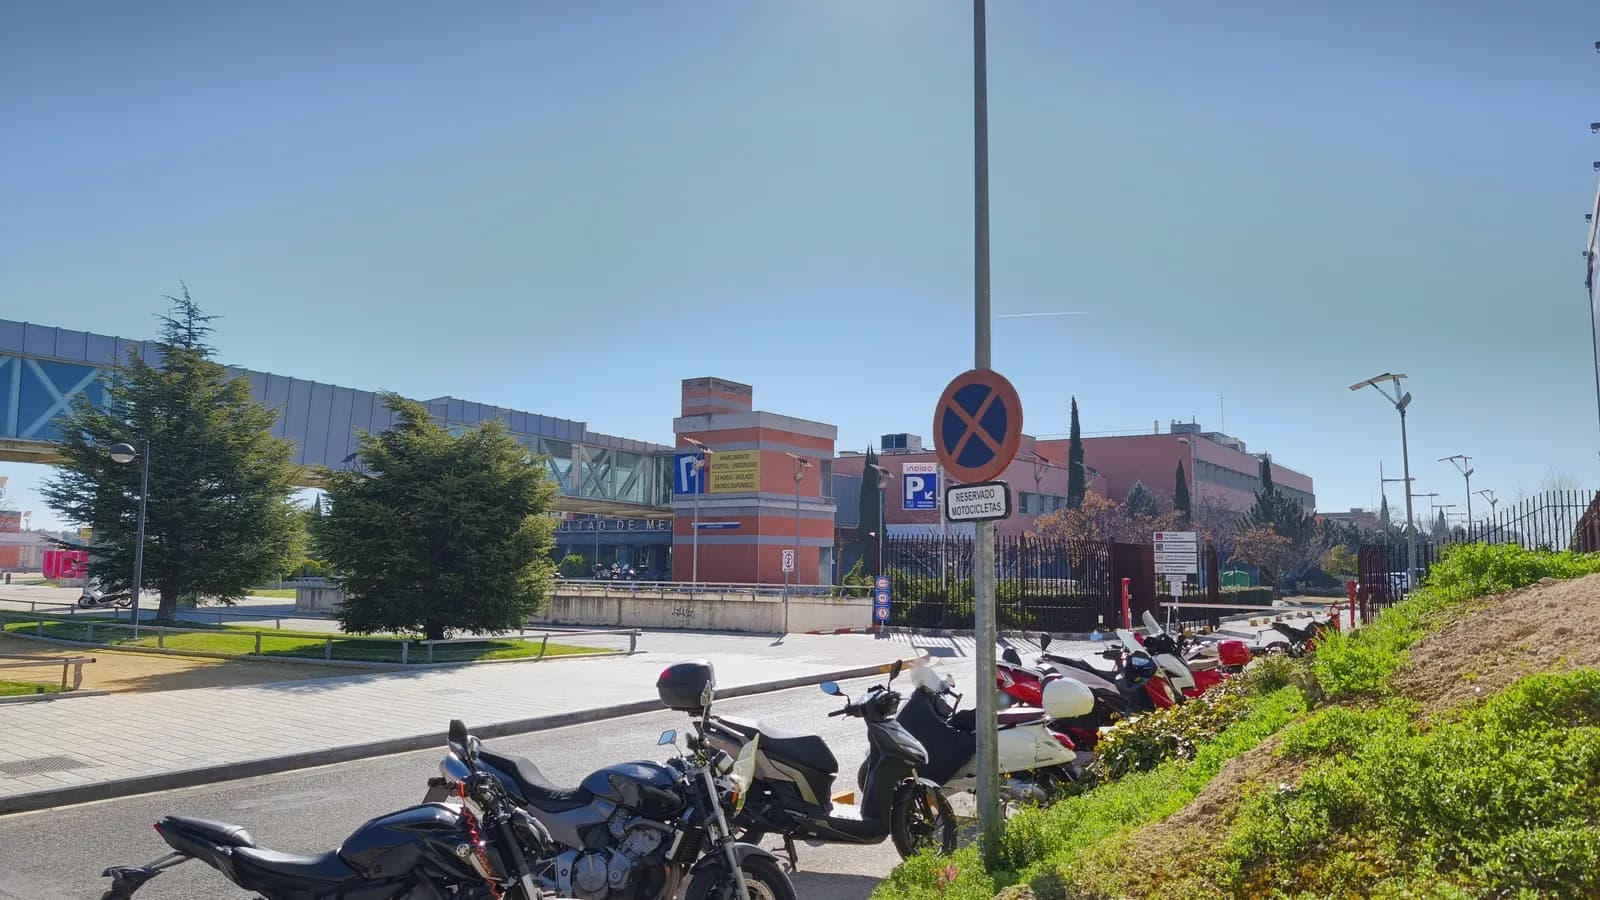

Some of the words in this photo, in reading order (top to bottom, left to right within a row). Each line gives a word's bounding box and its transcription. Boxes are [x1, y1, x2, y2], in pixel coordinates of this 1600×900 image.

[906, 477, 924, 499] P
[955, 489, 995, 502] RESERVADO
[951, 502, 1002, 516] MOTOCICLETAS
[617, 520, 635, 530] DE
